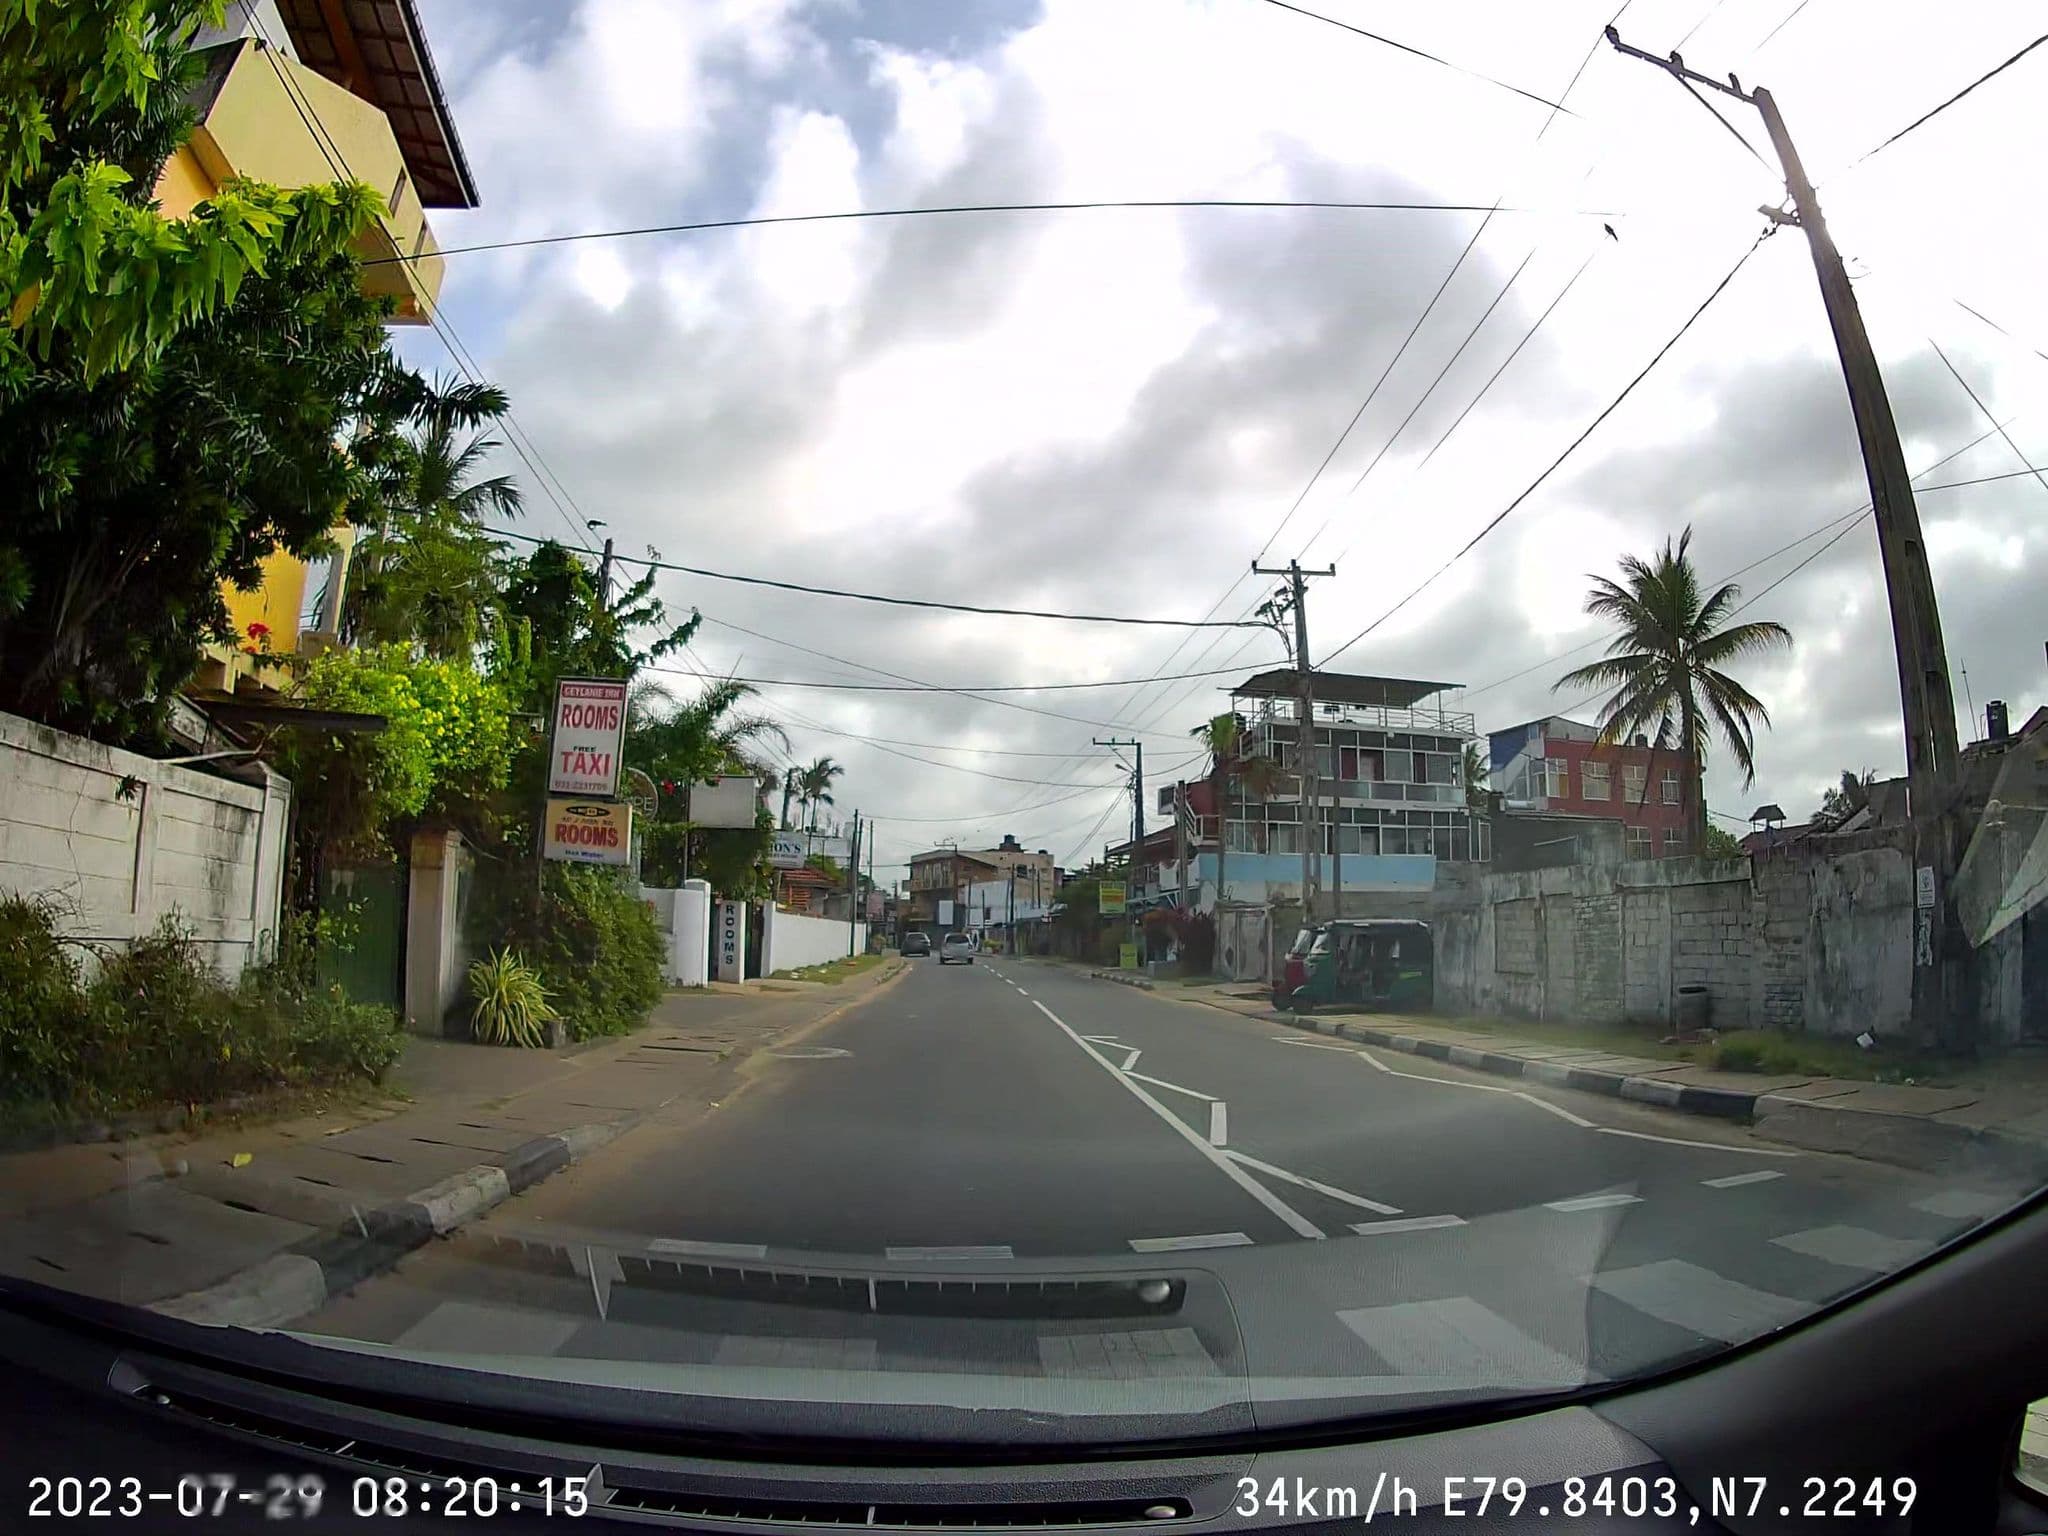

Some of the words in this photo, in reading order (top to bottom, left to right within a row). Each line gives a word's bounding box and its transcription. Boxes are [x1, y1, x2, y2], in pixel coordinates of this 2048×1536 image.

[561, 704, 619, 731] ROOMS
[561, 751, 611, 777] TAXI
[555, 823, 619, 848] ROOMS
[724, 904, 735, 966] ROOMS
